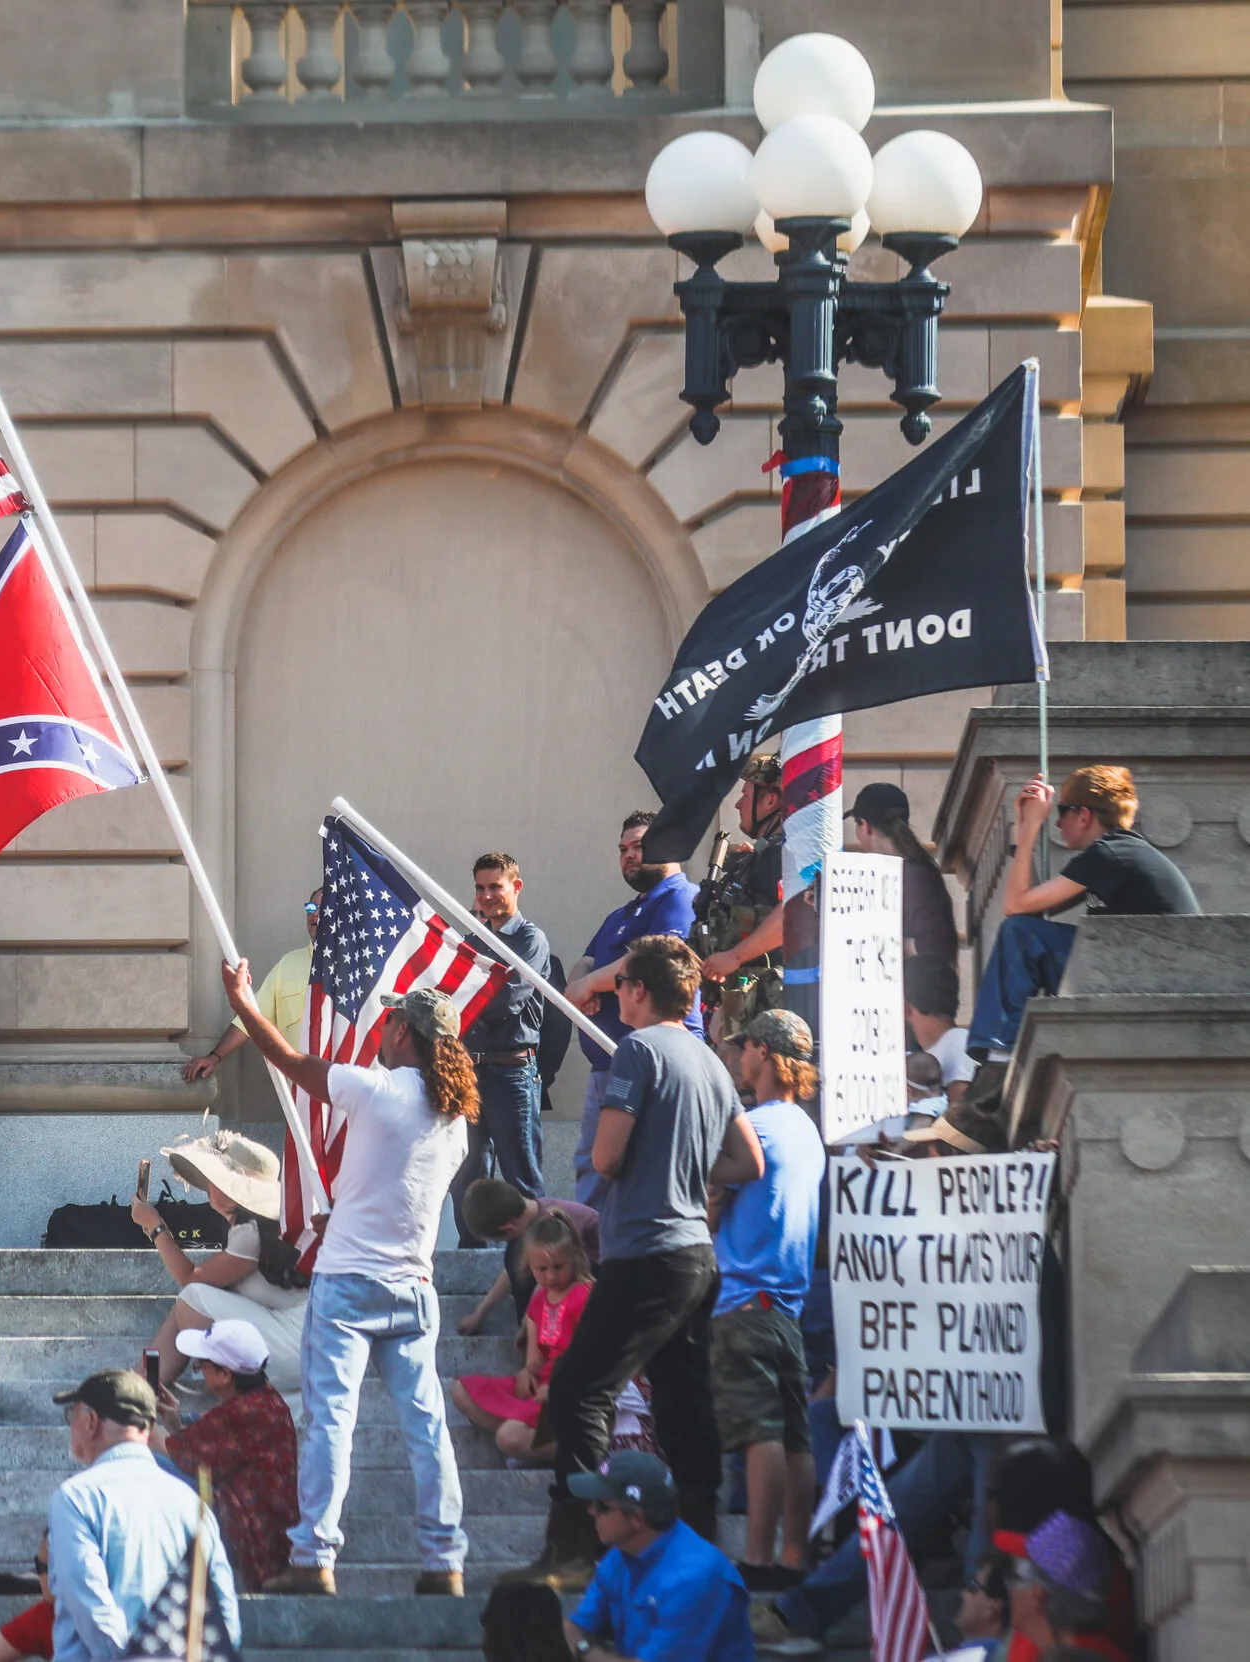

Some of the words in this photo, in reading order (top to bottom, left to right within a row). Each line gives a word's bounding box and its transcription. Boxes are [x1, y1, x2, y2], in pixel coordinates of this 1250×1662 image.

[837, 1165, 918, 1216] KILL
[937, 1162, 1049, 1215] PEOPLE?!
[993, 1231, 1043, 1284] YOUR
[860, 1300, 917, 1350] BFF
[937, 1302, 1026, 1354] PLANNED
[863, 1367, 1025, 1422] PARENTHOOD
